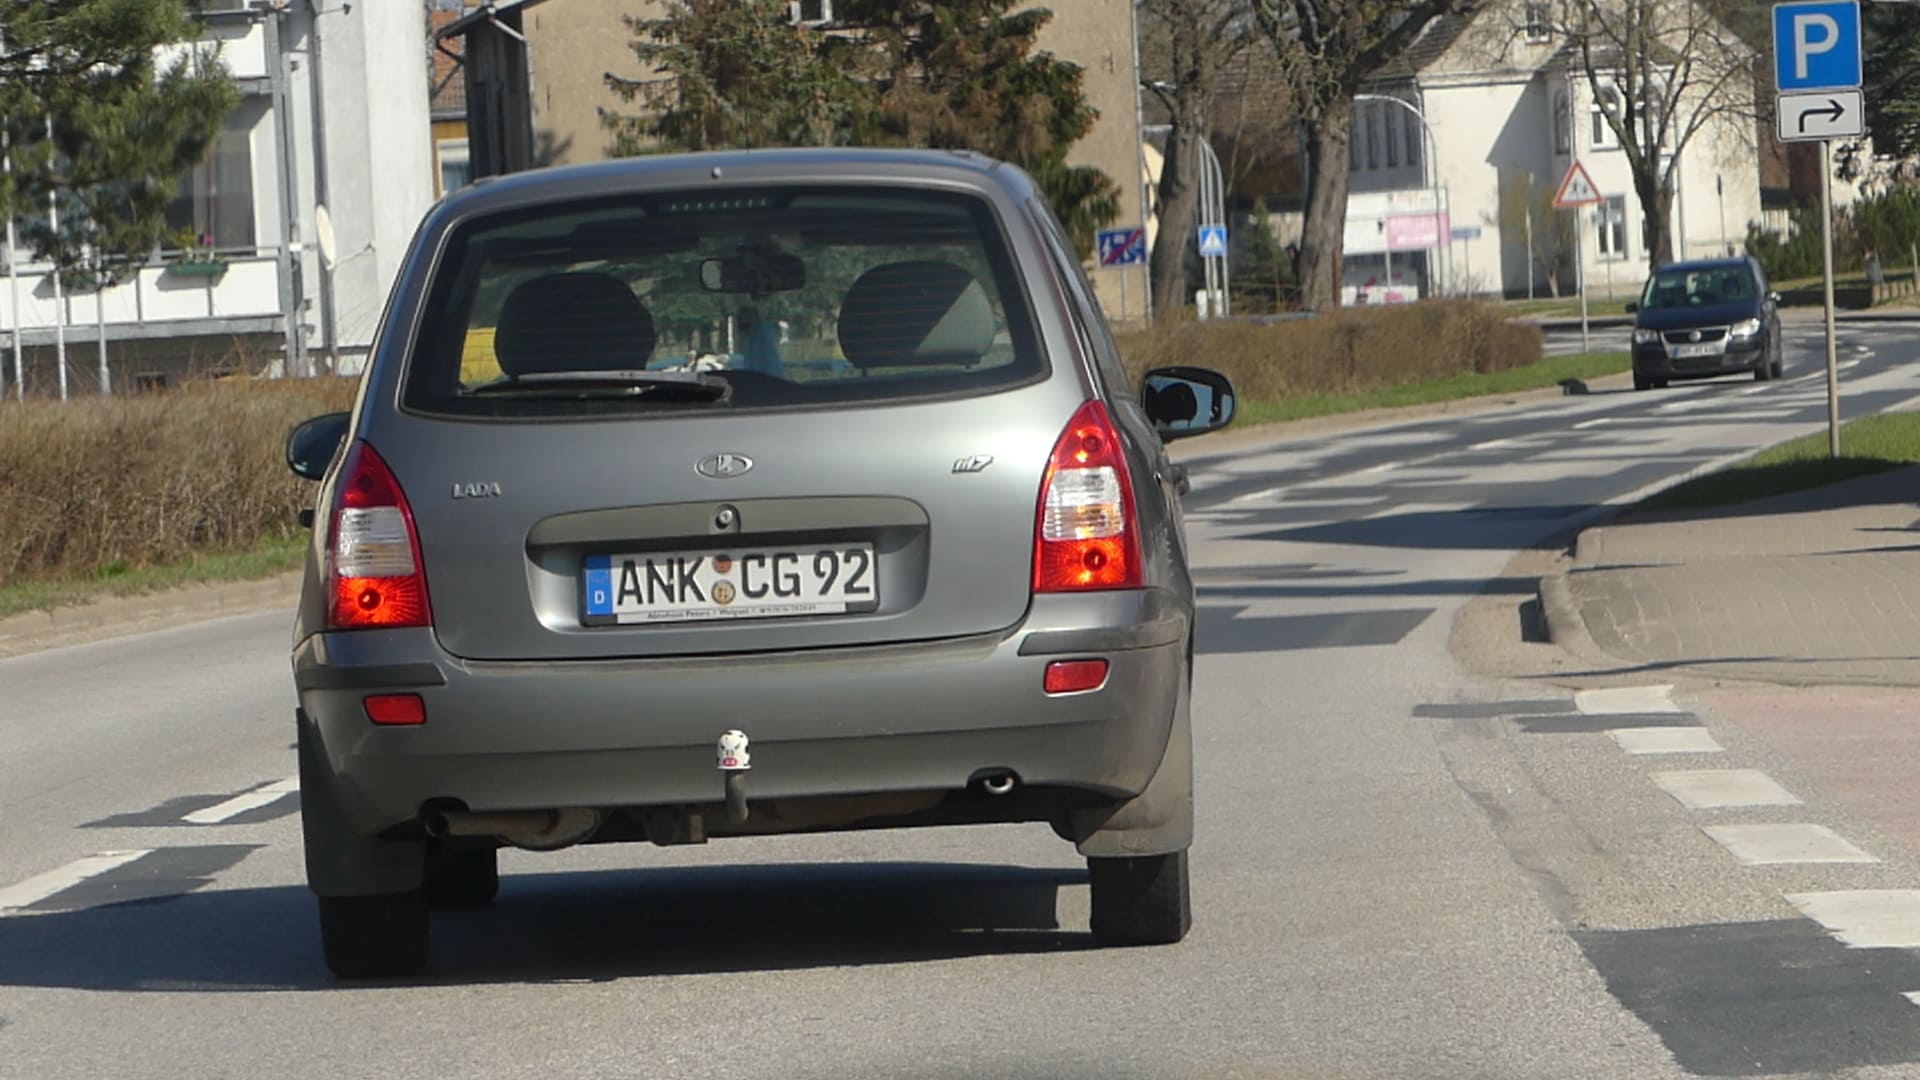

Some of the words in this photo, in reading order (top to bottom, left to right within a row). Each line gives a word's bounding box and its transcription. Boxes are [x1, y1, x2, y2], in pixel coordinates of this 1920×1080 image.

[1794, 13, 1839, 79] P
[452, 482, 502, 499] LADA
[617, 557, 706, 606] ANK
[741, 552, 801, 598] CG
[813, 549, 870, 595] 92
[594, 590, 605, 605] D
